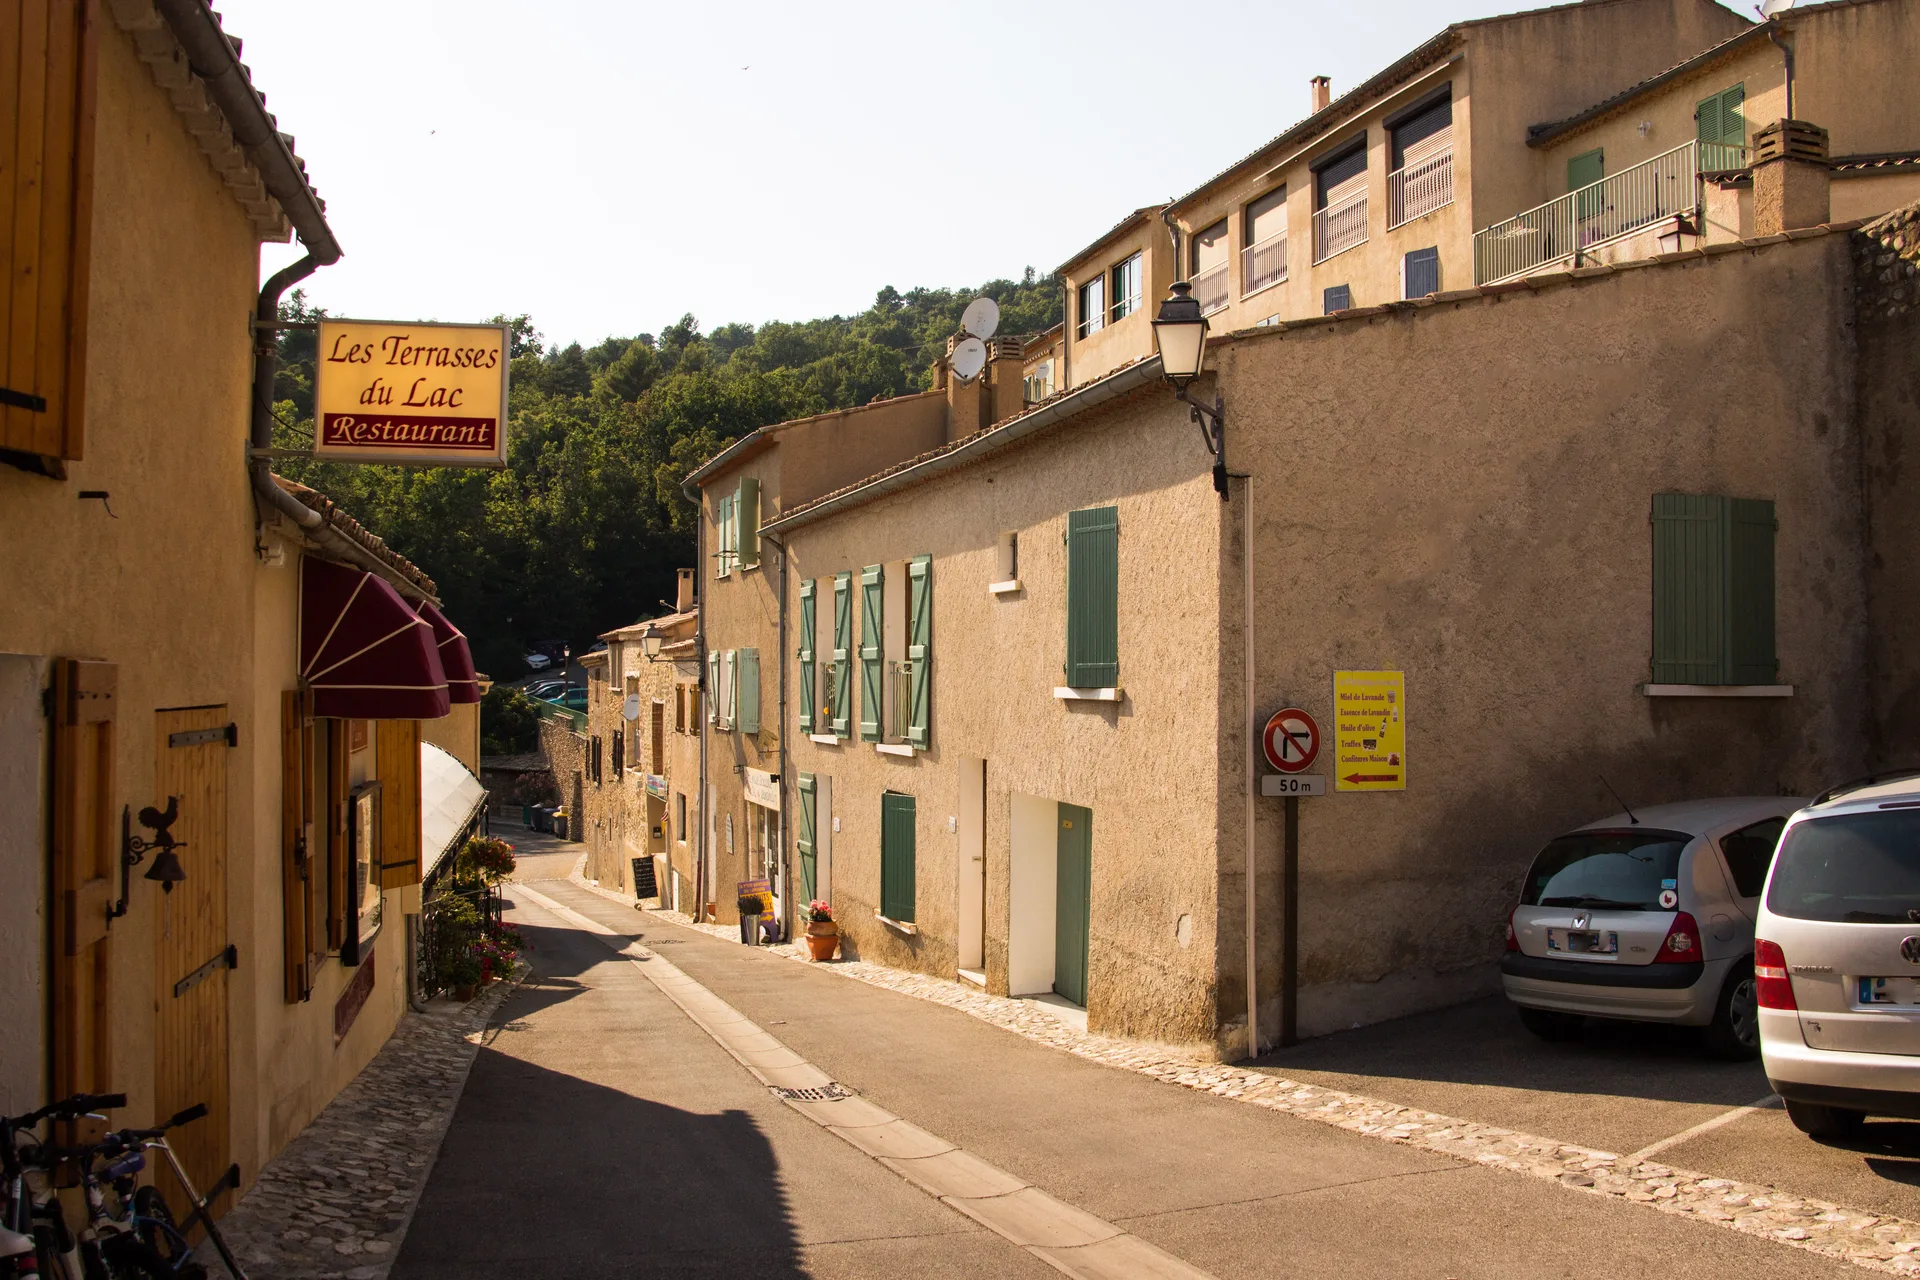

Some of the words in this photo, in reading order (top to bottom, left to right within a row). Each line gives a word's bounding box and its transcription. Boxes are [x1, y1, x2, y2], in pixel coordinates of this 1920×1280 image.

[327, 334, 374, 363] Les
[381, 335, 498, 369] Terrasses
[359, 377, 393, 406] du
[401, 377, 463, 408] Lac
[331, 416, 490, 444] Restaurant
[1340, 693, 1352, 701] Miel
[1353, 693, 1361, 701] de
[1361, 693, 1385, 701] Lavande
[1340, 708, 1360, 716] Essence
[1361, 708, 1368, 716] de
[1368, 708, 1391, 716] Lavandin
[1340, 723, 1356, 732] Huile
[1357, 723, 1376, 732] d'olive
[1341, 740, 1361, 748] Truffes
[1341, 754, 1368, 763] Confitures
[1369, 754, 1388, 762] Maison
[1280, 779, 1298, 792] 50
[1301, 783, 1311, 792] m
[1792, 964, 1832, 973] TOURAN
